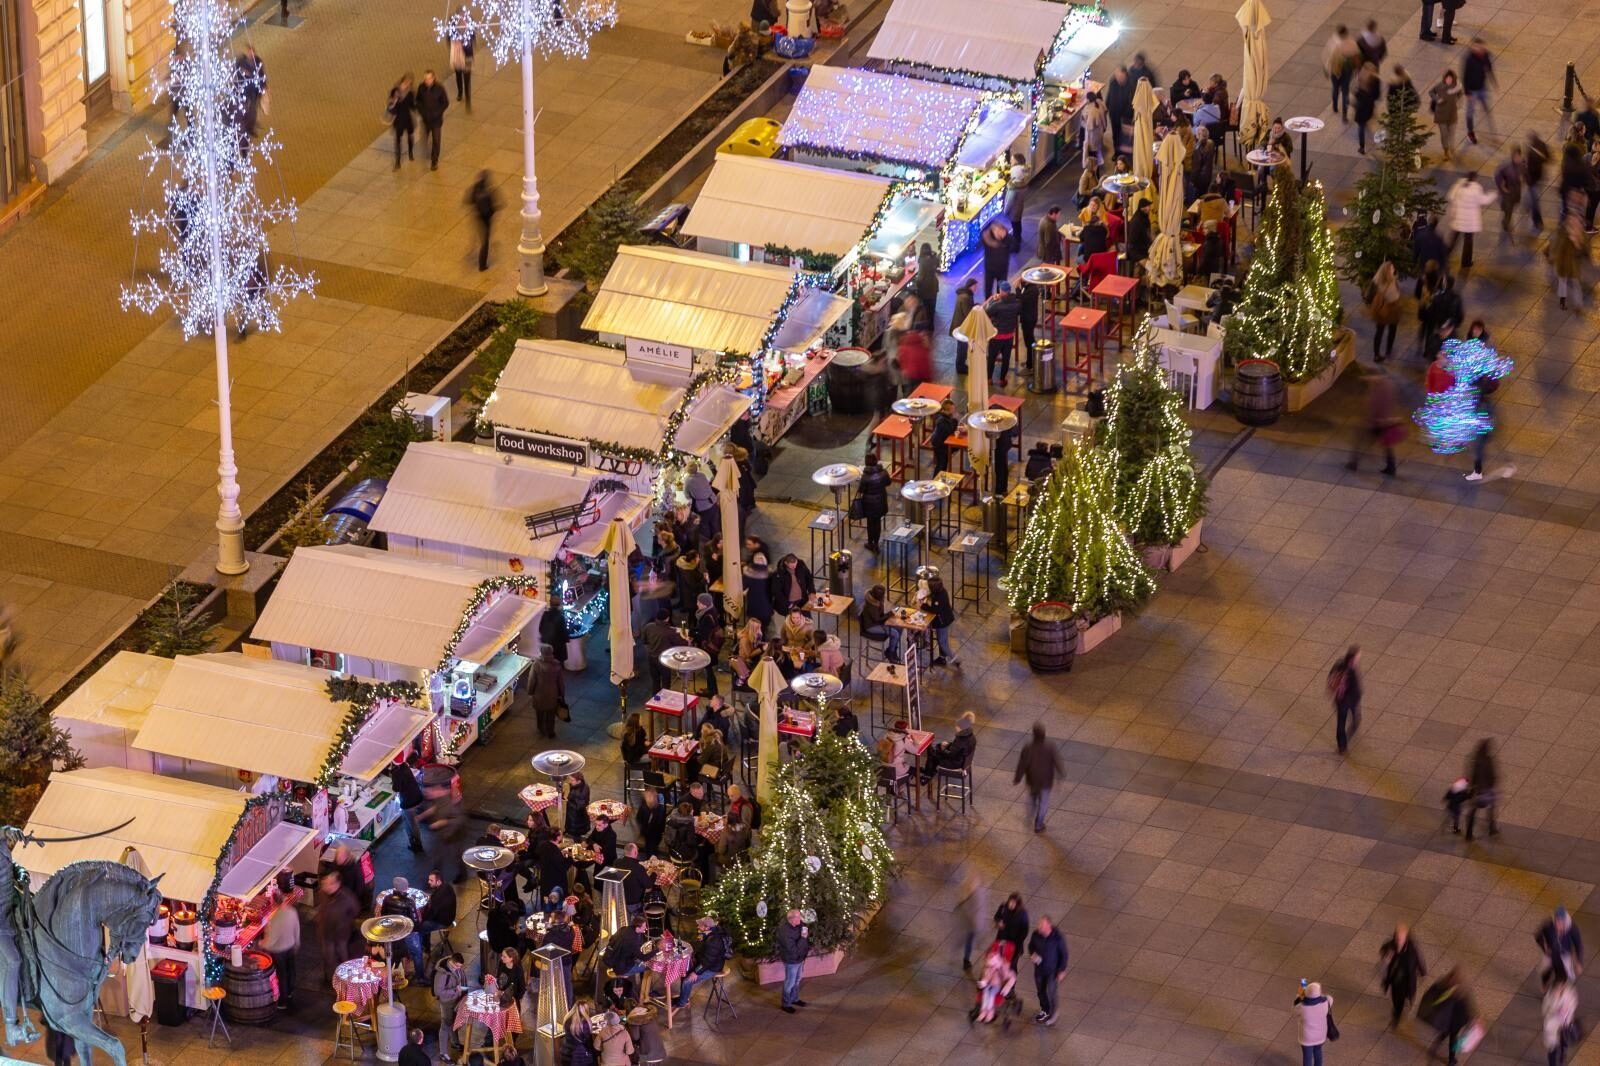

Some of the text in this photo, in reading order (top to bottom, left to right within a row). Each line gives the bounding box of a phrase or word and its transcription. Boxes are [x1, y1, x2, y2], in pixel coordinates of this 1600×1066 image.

[639, 346, 680, 359] AMÉLIE
[500, 435, 583, 462] food workshop
